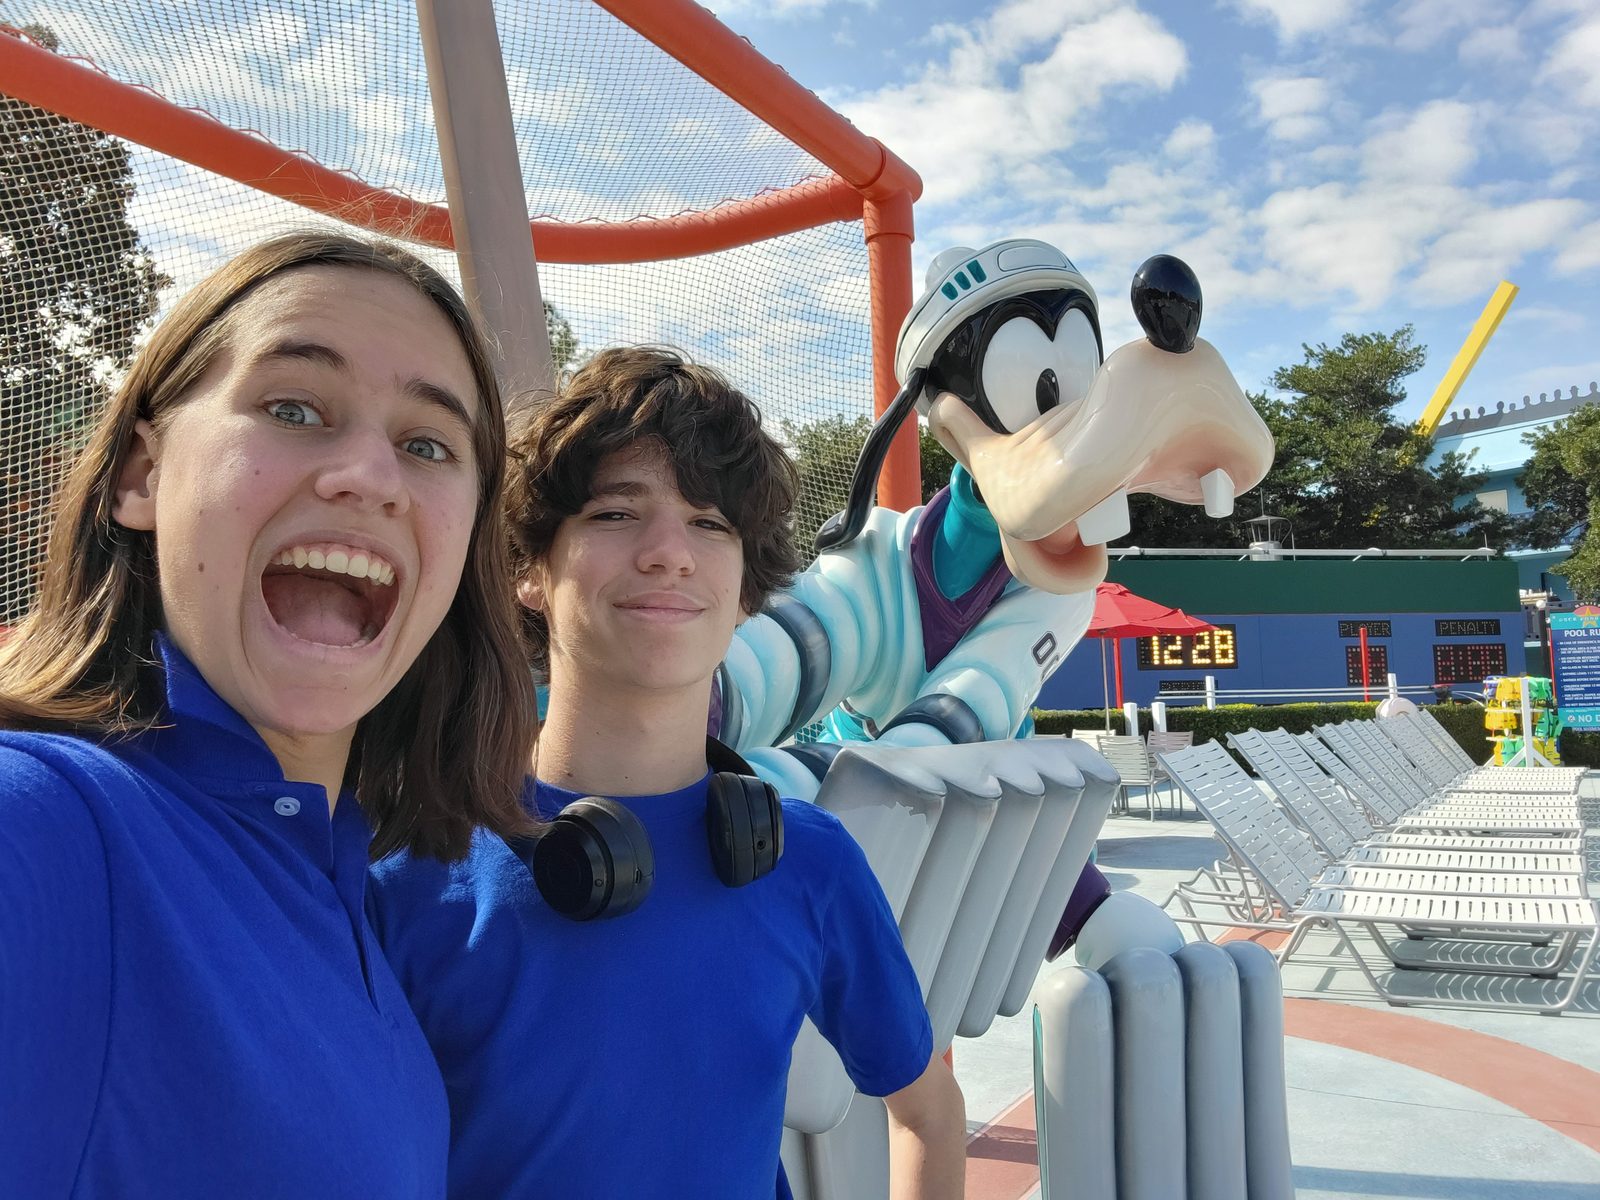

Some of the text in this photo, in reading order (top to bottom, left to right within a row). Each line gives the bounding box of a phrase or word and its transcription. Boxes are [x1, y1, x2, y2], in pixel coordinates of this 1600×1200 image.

[1439, 621, 1496, 635] PENALTY
[1564, 629, 1588, 637] POOL
[1578, 714, 1593, 723] NO
